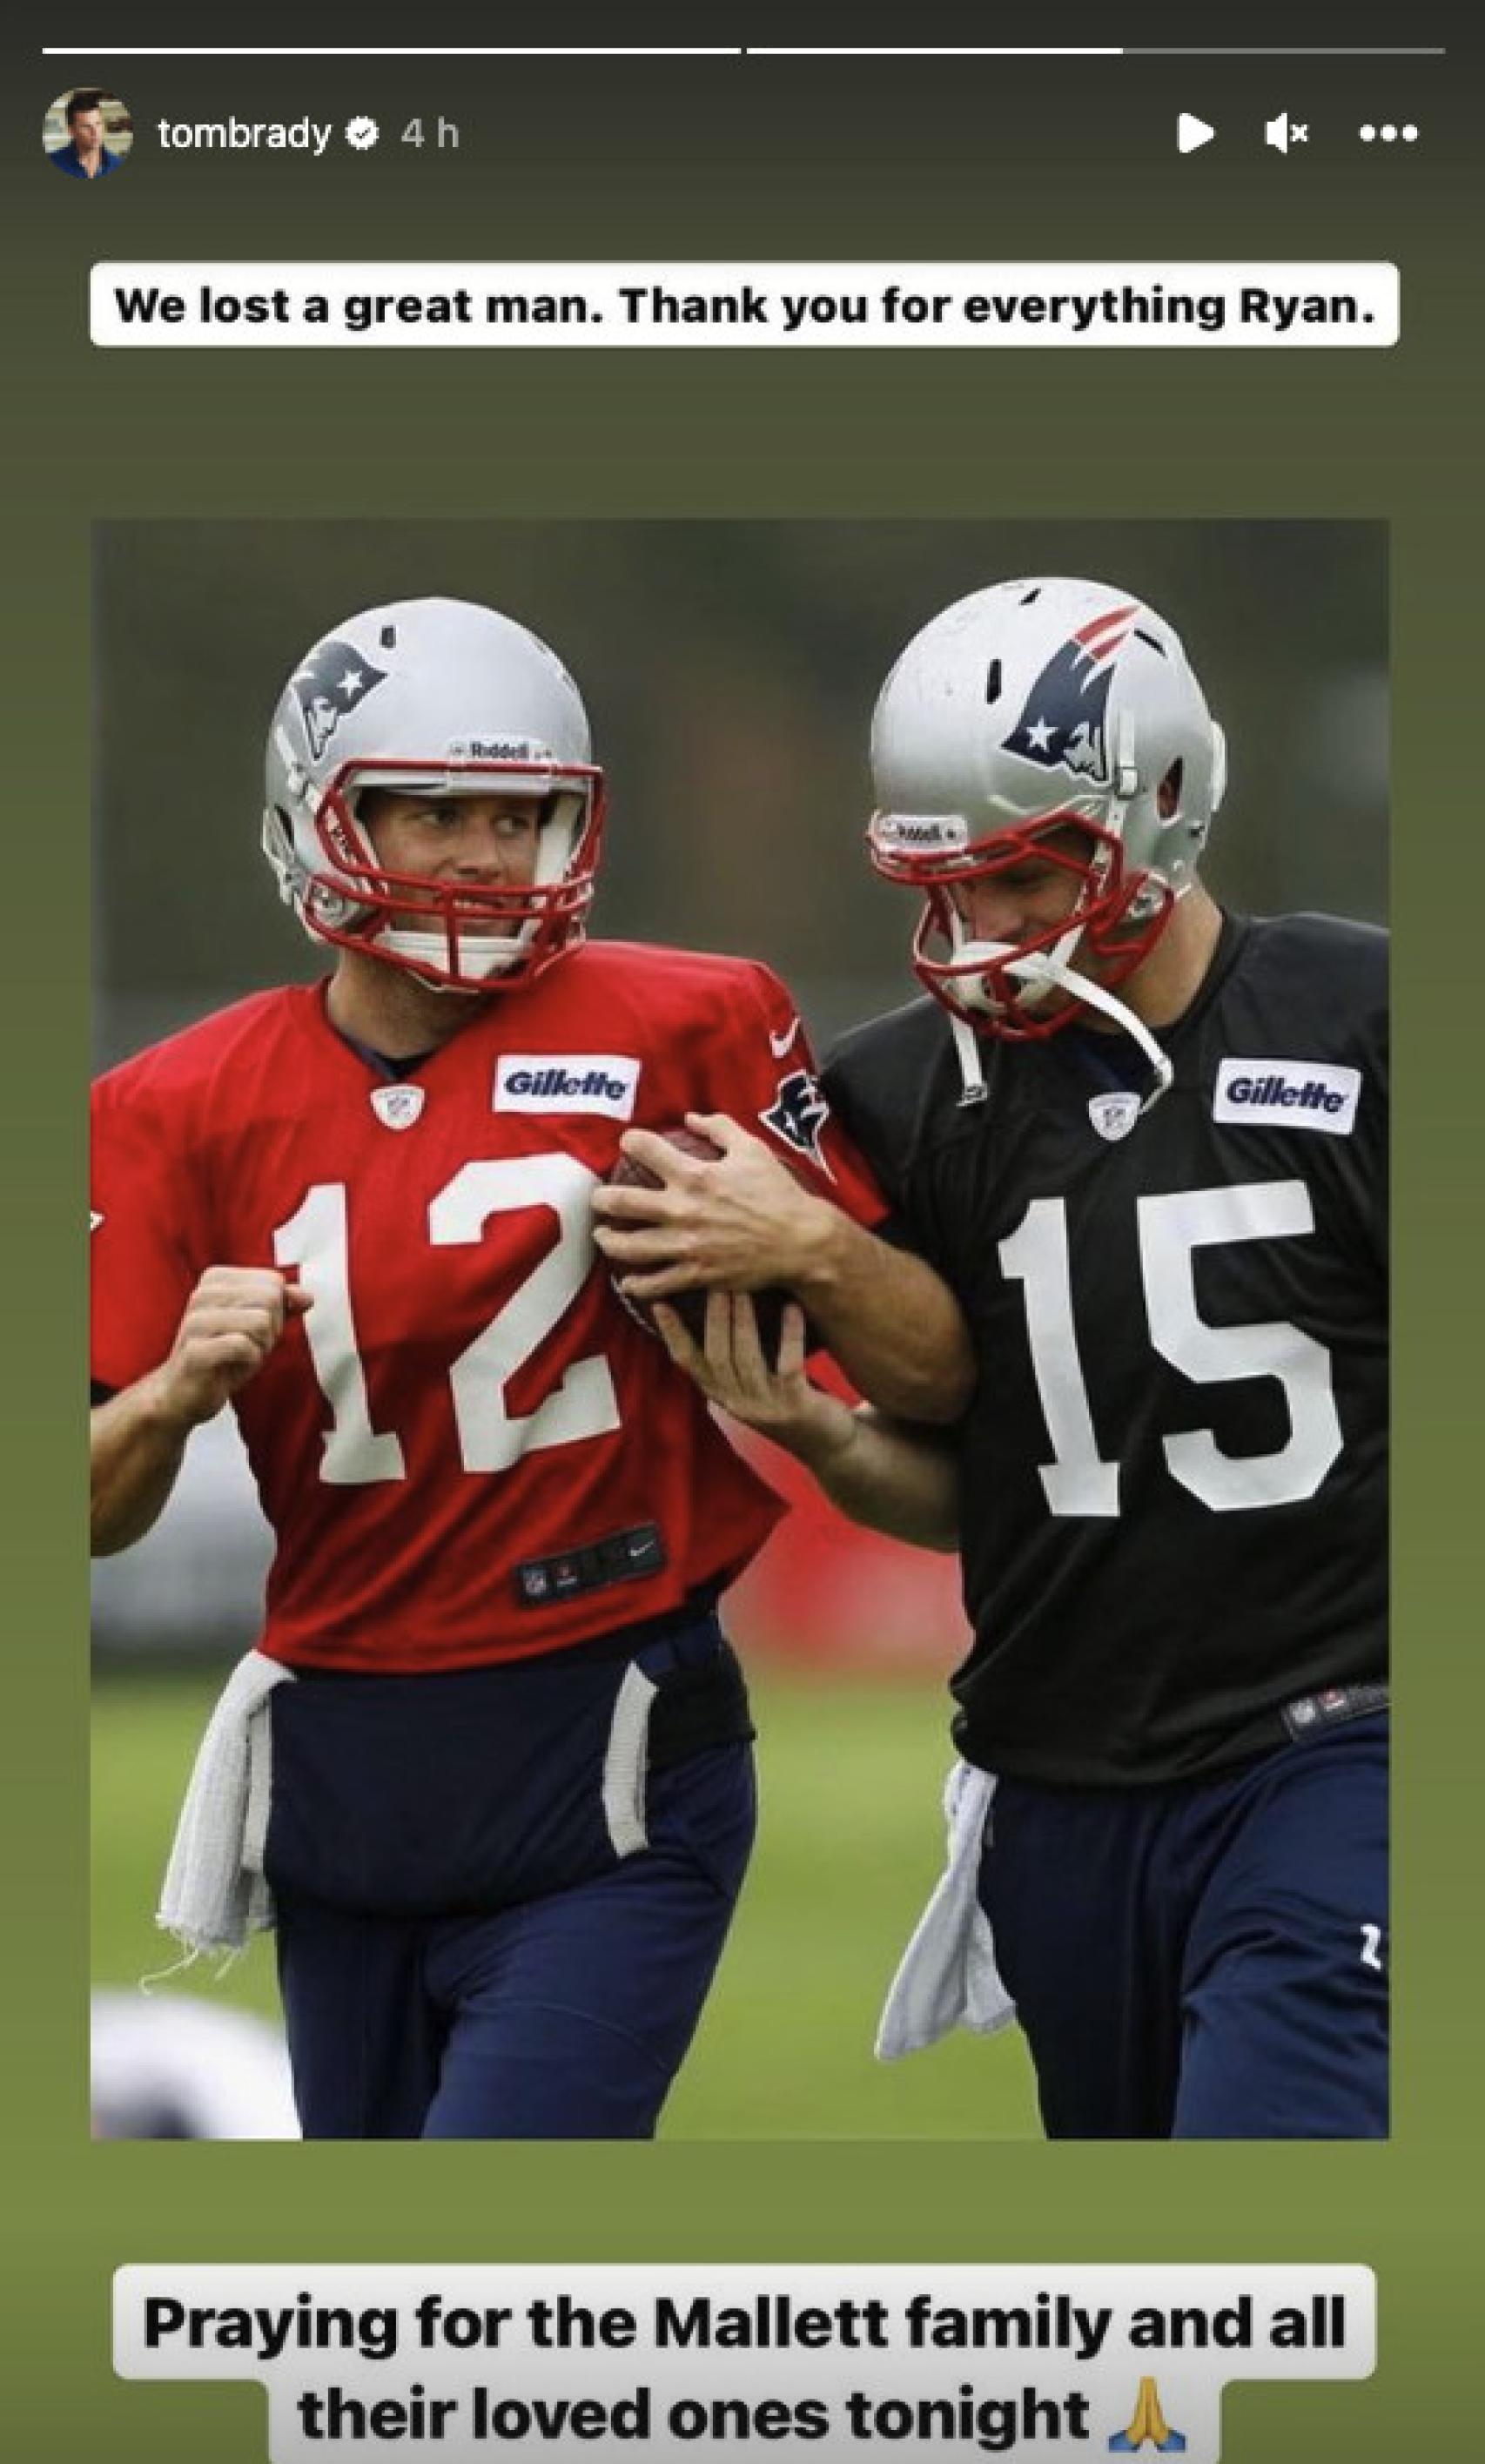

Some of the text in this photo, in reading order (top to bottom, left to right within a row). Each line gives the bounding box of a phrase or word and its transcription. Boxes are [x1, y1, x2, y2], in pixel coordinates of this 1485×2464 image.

[504, 1067, 627, 1101] Gillette
[1226, 1074, 1346, 1114] Gillette
[272, 1151, 622, 1483] 12
[998, 1179, 1345, 1518] 15
